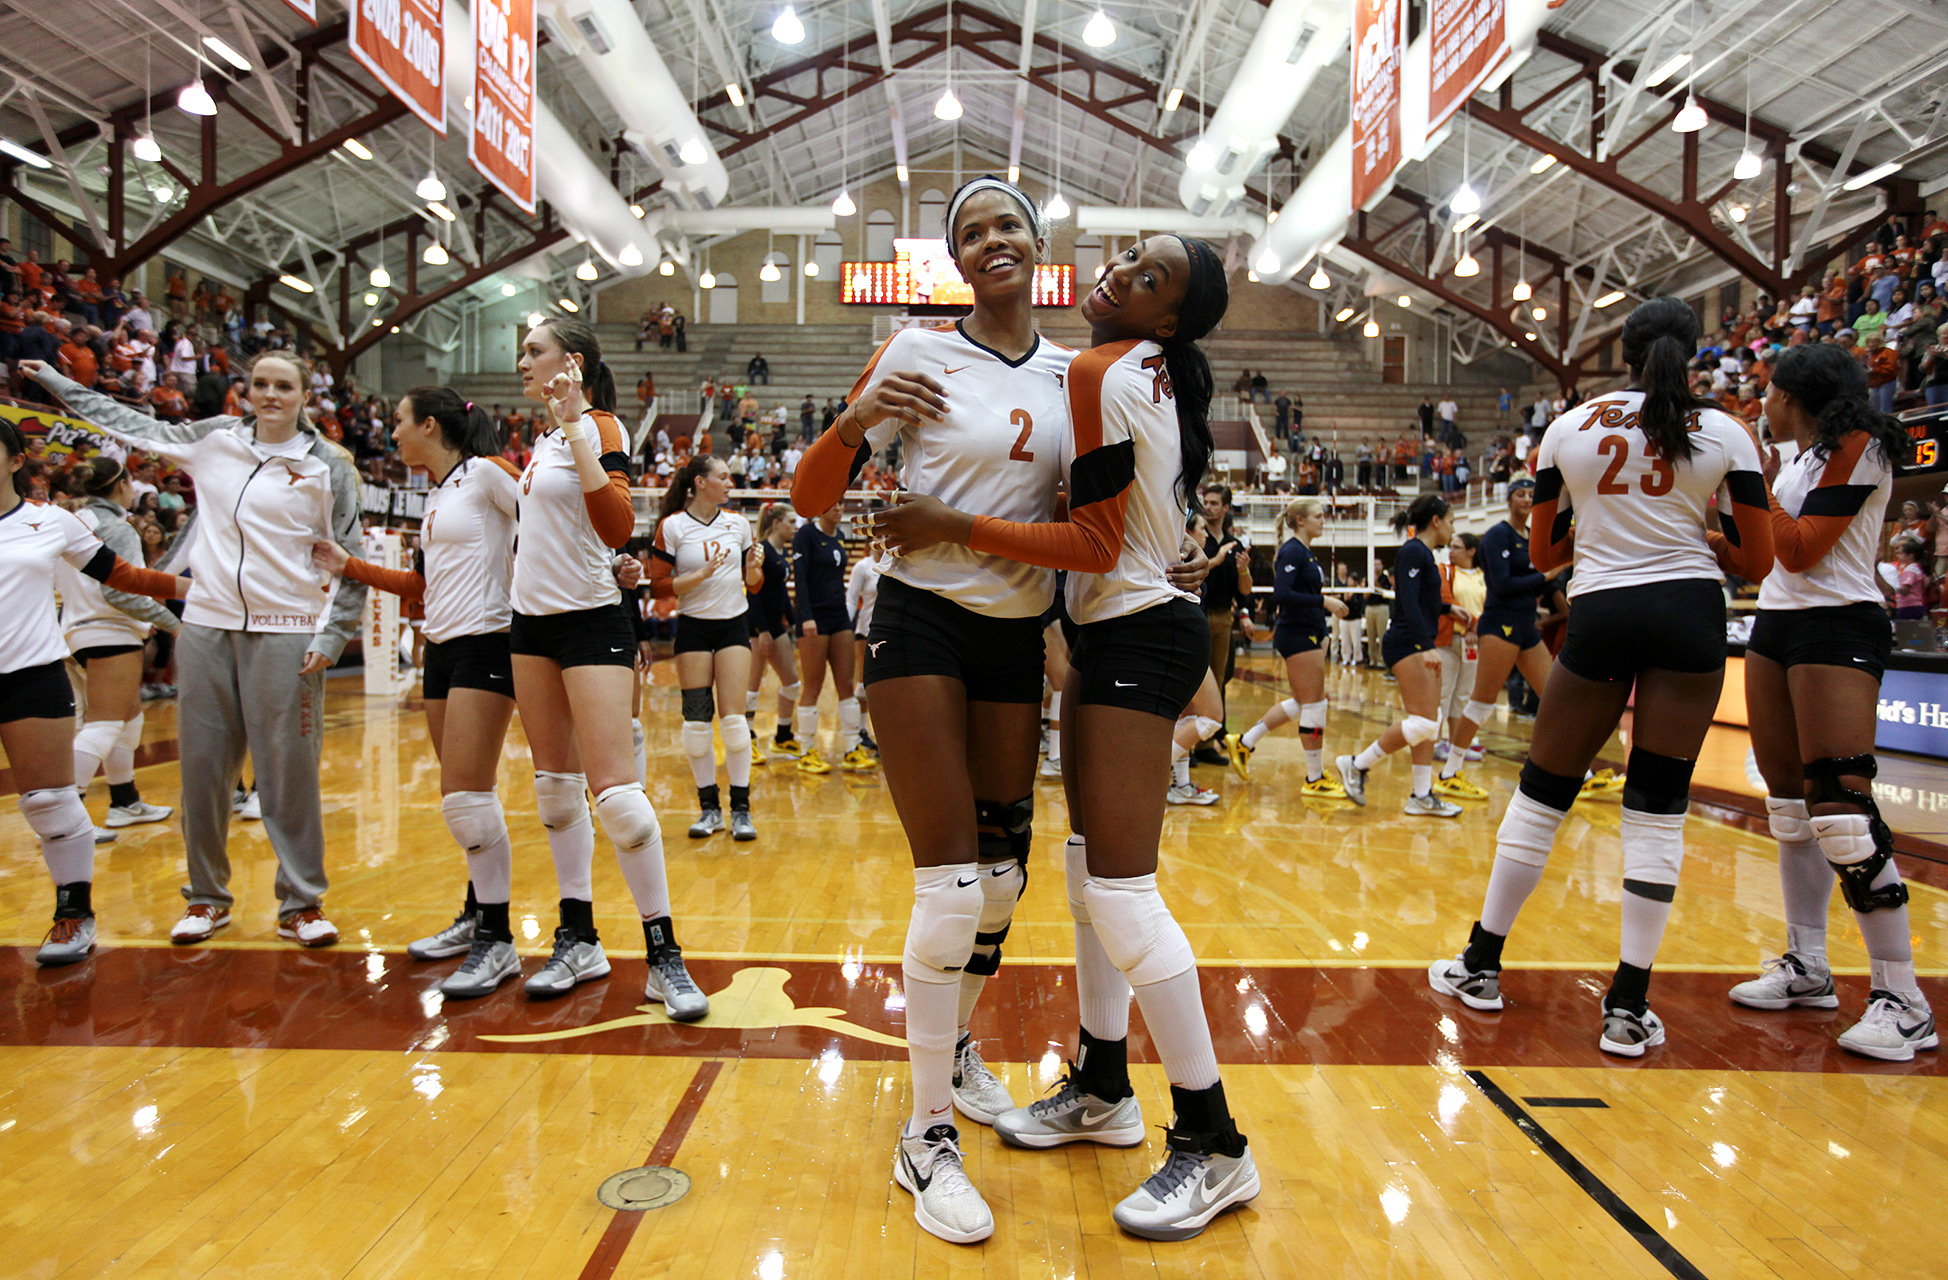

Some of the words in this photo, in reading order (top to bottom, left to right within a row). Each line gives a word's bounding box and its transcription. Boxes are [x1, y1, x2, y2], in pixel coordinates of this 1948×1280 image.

[403, 11, 440, 87] 2009
[512, 32, 530, 95] 12
[1009, 408, 1034, 462] 2
[1578, 400, 1703, 432] Texs
[1597, 434, 1675, 497] 23
[1916, 441, 1935, 464] 15
[703, 541, 721, 562] 12
[832, 549, 842, 567] 9
[251, 614, 320, 627] VOLLEYBAL
[301, 690, 312, 737] TEXAS
